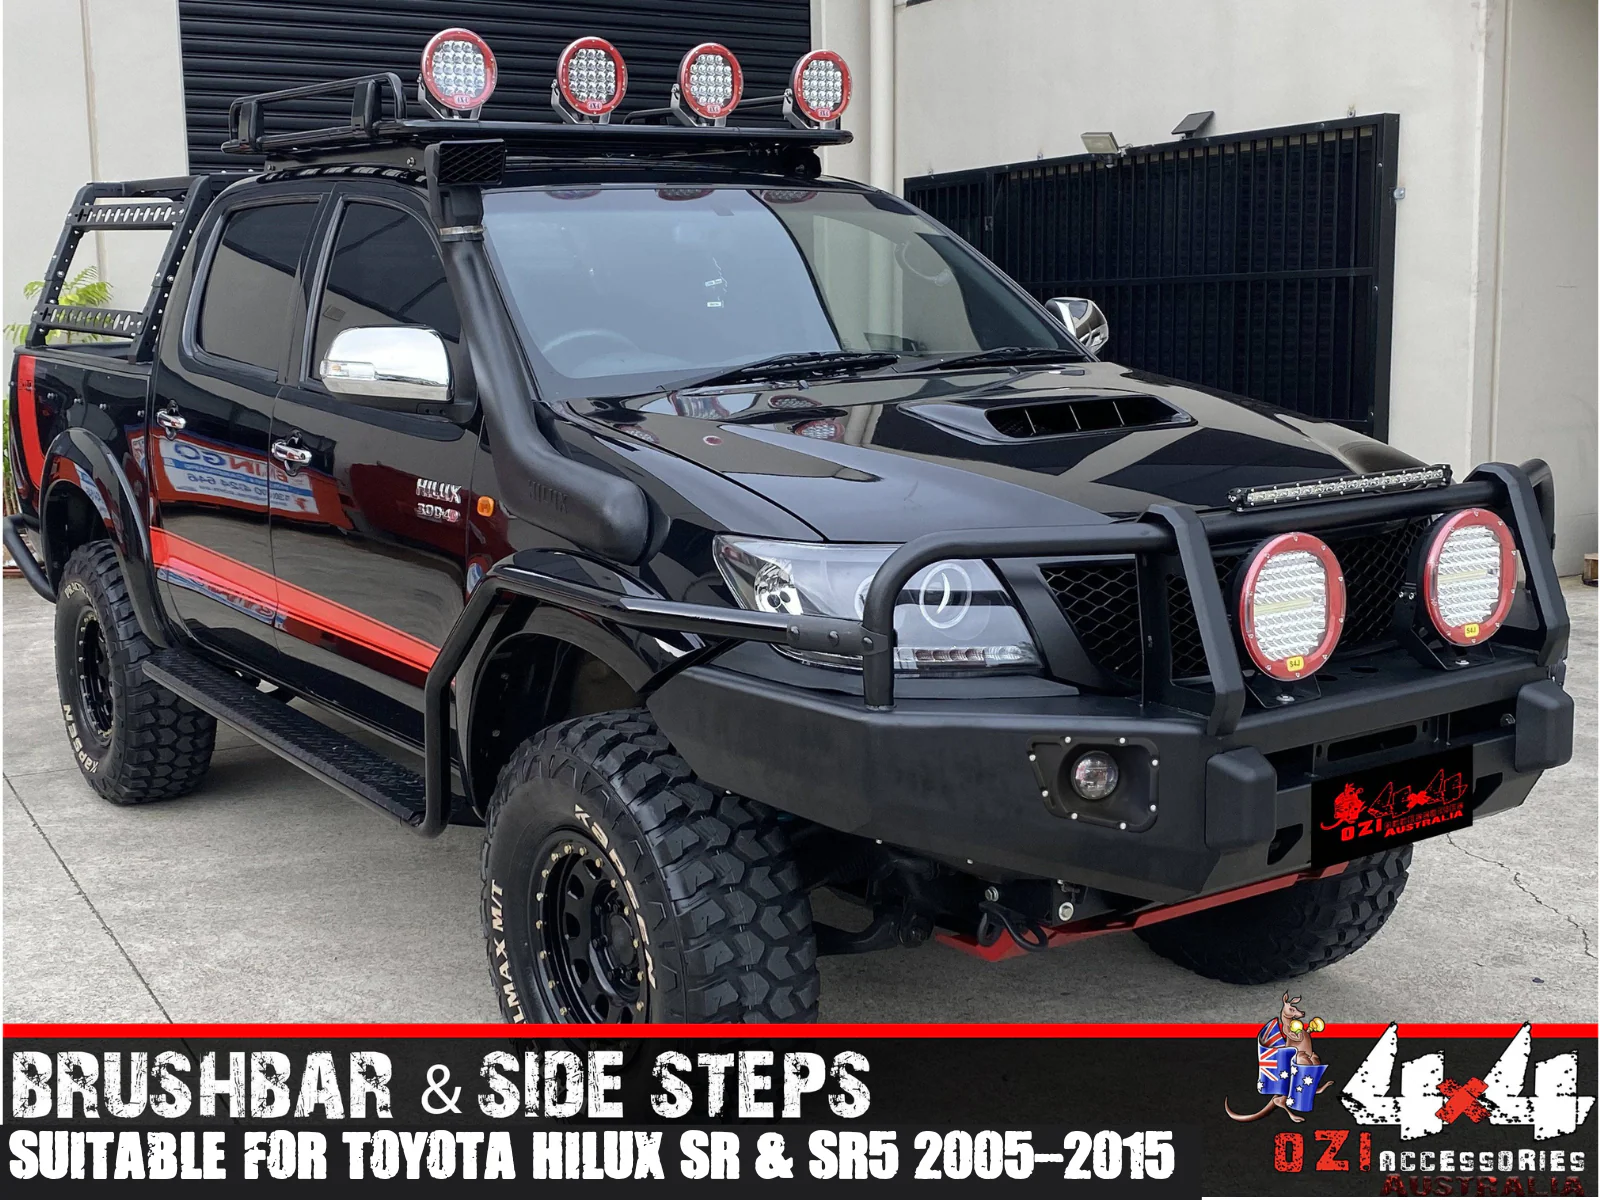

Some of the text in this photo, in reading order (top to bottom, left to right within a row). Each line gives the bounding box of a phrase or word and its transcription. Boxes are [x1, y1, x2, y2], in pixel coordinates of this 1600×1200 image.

[416, 478, 462, 504] HILUX
[491, 879, 527, 1024] LMAX M/T
